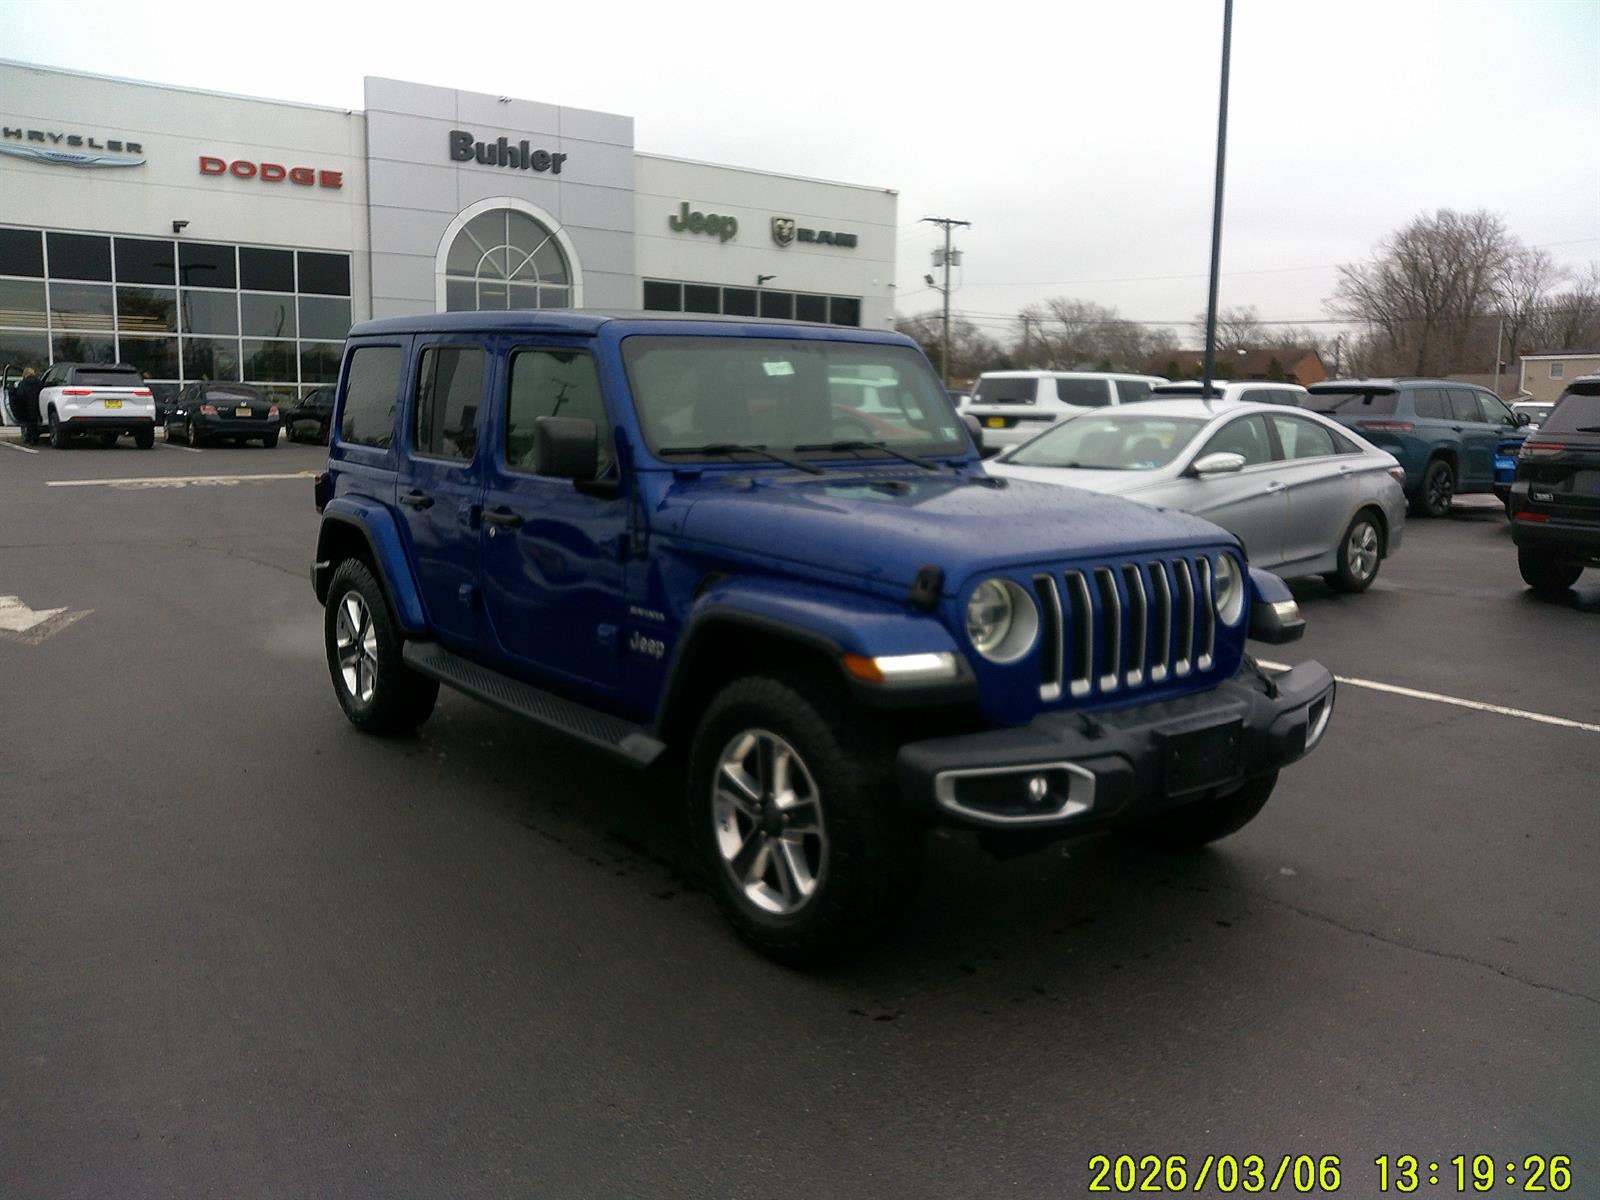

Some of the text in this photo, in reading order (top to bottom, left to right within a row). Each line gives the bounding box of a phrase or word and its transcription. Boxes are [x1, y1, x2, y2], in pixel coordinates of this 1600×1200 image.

[1, 127, 143, 154] HRYSLER
[449, 130, 567, 174] Buhler
[199, 156, 343, 189] DODGE
[669, 201, 738, 243] Jeep
[629, 630, 665, 660] Jeep
